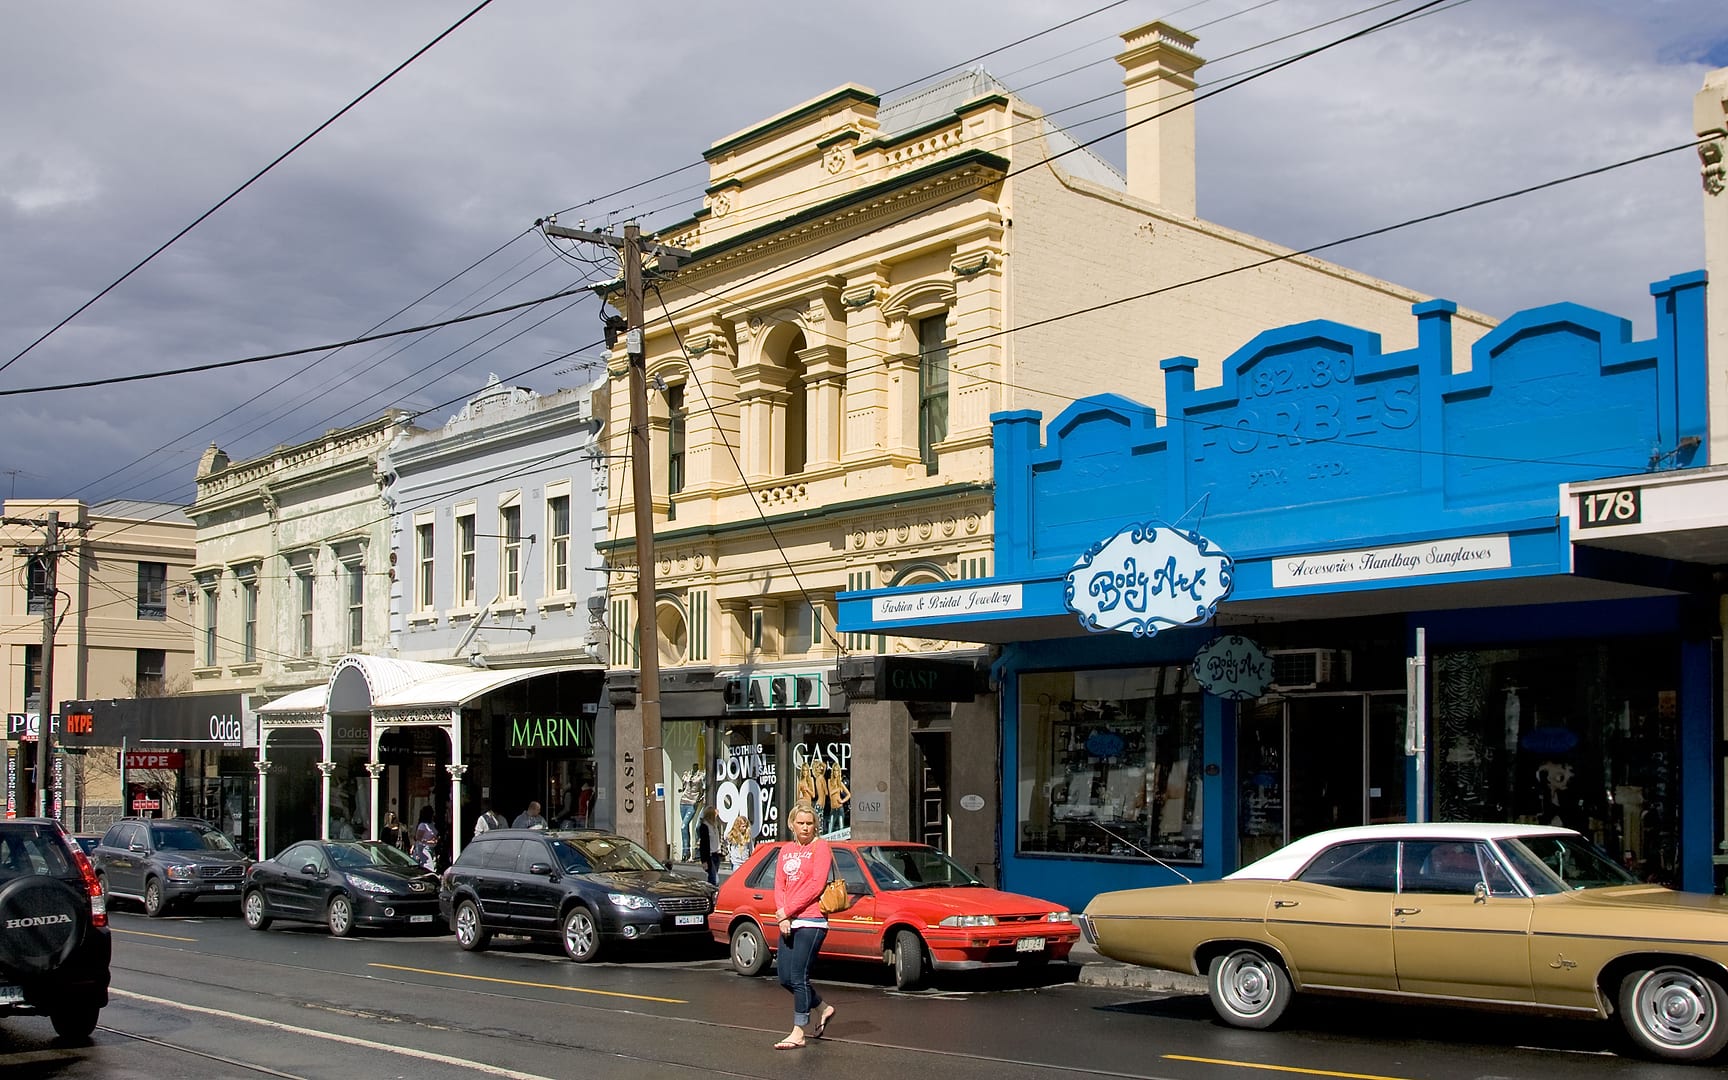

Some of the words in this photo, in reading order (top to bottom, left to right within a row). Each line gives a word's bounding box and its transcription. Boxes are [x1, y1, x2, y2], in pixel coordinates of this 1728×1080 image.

[1194, 384, 1420, 463] FORBES
[1585, 490, 1636, 522] 178
[1288, 559, 1354, 577] Accessories
[1359, 552, 1421, 571] Handbags
[1426, 546, 1492, 567] Sunglasses
[1089, 557, 1149, 612] Body
[1152, 556, 1206, 601] Art
[881, 600, 913, 613] Fashion
[917, 597, 925, 611] &
[928, 595, 962, 609] Bridal
[965, 591, 1012, 609] Jewellery
[1207, 649, 1239, 683] Body
[1239, 652, 1265, 680] Art
[892, 669, 937, 689] GASP
[67, 715, 93, 733] HYPE
[210, 714, 241, 740] Odda
[337, 727, 369, 738] Odda
[729, 744, 763, 756] CLOTHING
[793, 742, 851, 770] GASP
[125, 756, 169, 767] HYPE
[716, 753, 767, 781] DOWN
[759, 764, 776, 775] SALE
[624, 751, 635, 814] GASP
[858, 801, 881, 812] GASP
[762, 823, 778, 837] OFF
[6, 914, 73, 929] HONDA
